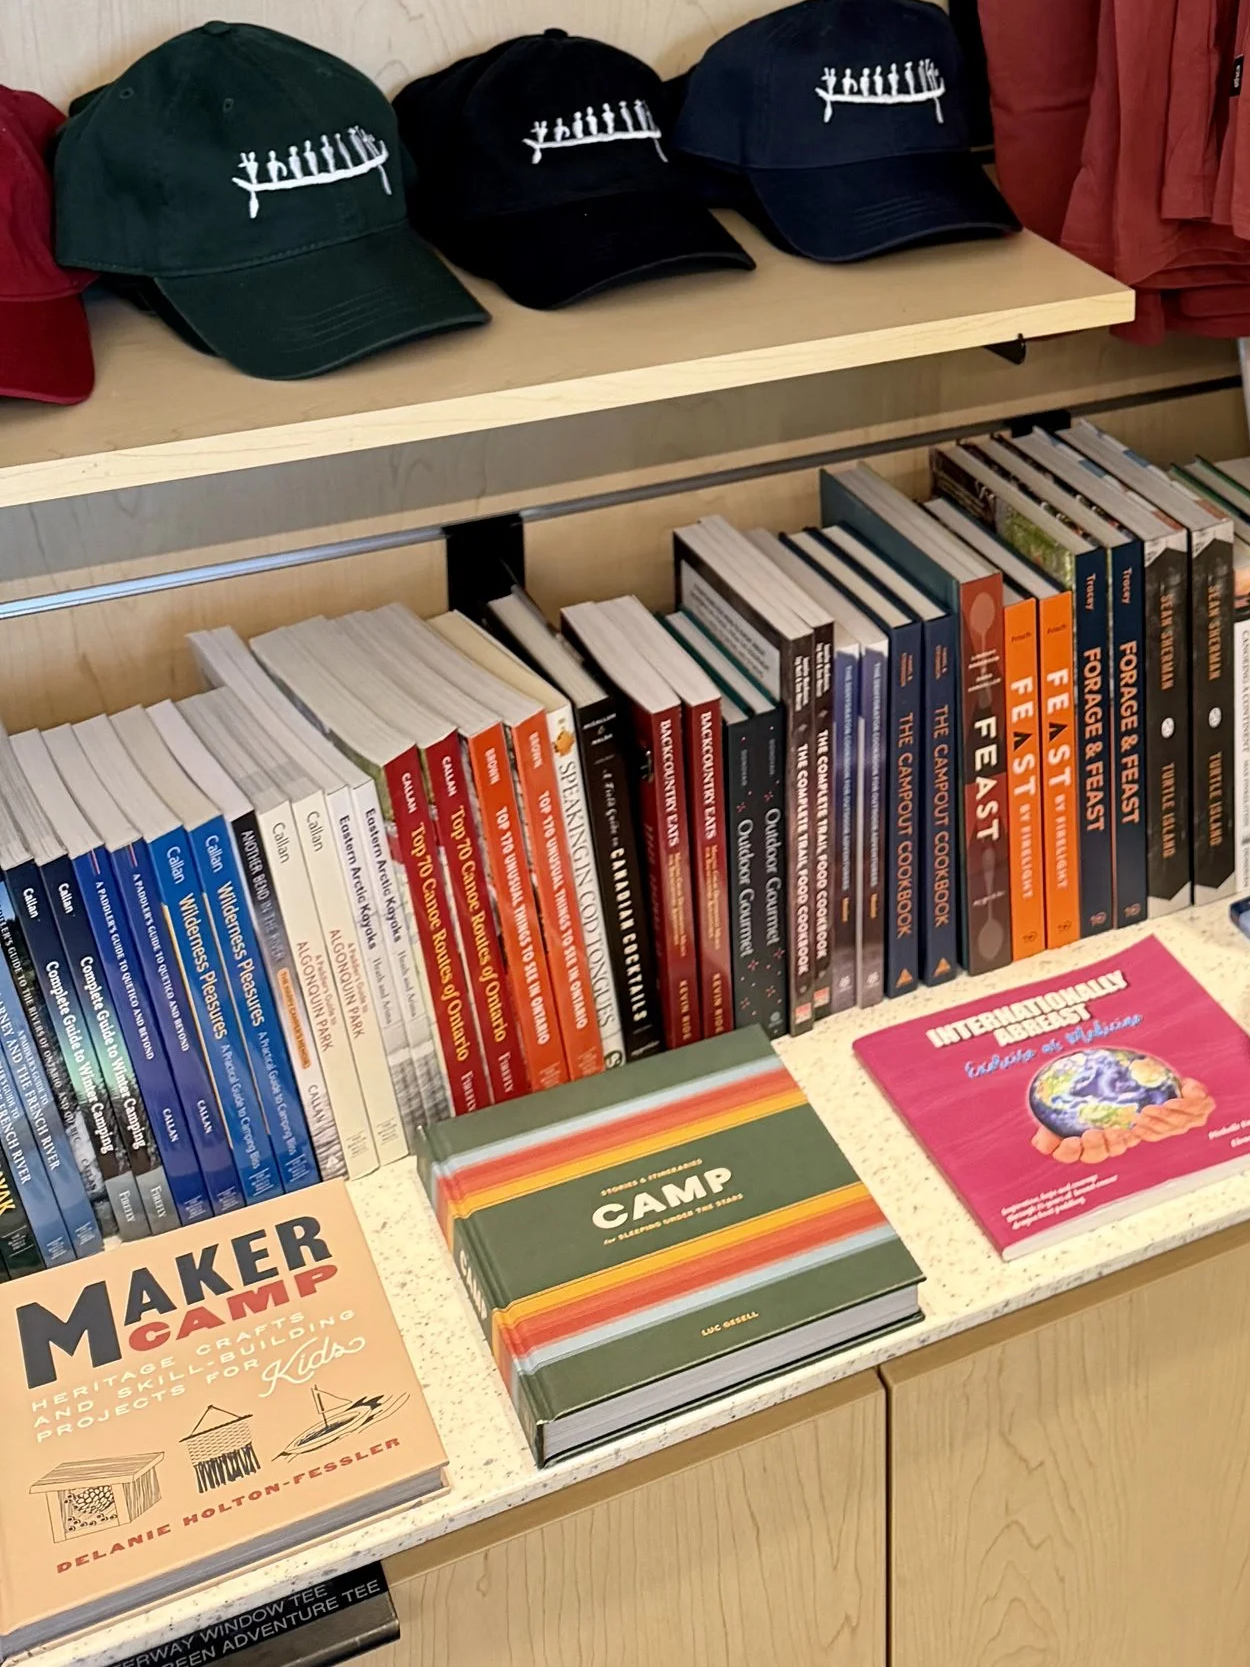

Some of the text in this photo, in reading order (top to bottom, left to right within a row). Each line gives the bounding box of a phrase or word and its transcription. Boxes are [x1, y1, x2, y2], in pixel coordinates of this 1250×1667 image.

[1085, 572, 1097, 612] Tracey
[1160, 592, 1175, 692] SEAN SHERMAN
[1010, 675, 1036, 797] FEAST
[1083, 646, 1105, 832] FORAGE & FEAST
[401, 772, 418, 814] CALLAN
[659, 718, 678, 814] BACKCOUNTRY
[973, 715, 1000, 842] FEAST
[306, 810, 324, 853] Callan
[411, 821, 425, 856] Top
[496, 806, 509, 830] TOP
[666, 813, 680, 848] EATS
[897, 711, 914, 940] THE CAMPOUT COOKBOOK
[1161, 762, 1177, 860] TURTLE ISLAND
[272, 821, 290, 864] Callan
[417, 854, 435, 879] 70
[500, 829, 515, 855] 170
[1021, 824, 1034, 900] FIRELIGHT
[23, 887, 39, 919] Callan
[58, 883, 74, 914] Callan
[339, 814, 377, 951] Eastern Arctic Kayaks
[421, 876, 443, 932] Canoe
[504, 853, 524, 906] UNUSUAL
[559, 760, 616, 1028] SPEAKING IN COD TONGUES
[610, 847, 636, 931] CANADIAN
[737, 818, 755, 959] Outdoor Gourmet
[764, 807, 782, 946] Outdoor Gourmet
[166, 846, 228, 1041] Callan Wilderness Pleasures
[205, 834, 265, 1028] Callan Wilderness Pleasures
[512, 904, 532, 949] THINGS
[432, 927, 453, 984] Routes
[521, 946, 536, 963] TO
[524, 961, 539, 984] SEE
[622, 932, 648, 1023] COCKTAILS
[46, 960, 71, 1015] Complete
[80, 956, 104, 1011] Complete
[296, 941, 335, 1052] ALGONQUIN PARK
[329, 928, 366, 1040] ALGONQUIN PARK
[440, 982, 456, 1002] of
[528, 982, 542, 998] IN
[925, 969, 1129, 1049] INTERNATIONALLY
[63, 1014, 83, 1051] Guide
[96, 1009, 117, 1045] Guide
[447, 998, 471, 1062] Ontario
[529, 995, 551, 1046] ONTARIO
[993, 1002, 1093, 1047] ABREAST
[74, 1048, 85, 1063] to
[108, 1042, 119, 1058] to
[112, 1056, 132, 1099] Winter
[79, 1061, 99, 1103] Winter
[90, 1101, 113, 1155] Camping
[124, 1097, 146, 1150] Camping
[591, 1167, 732, 1230] CAMP
[600, 1158, 703, 1197] STORIES & ITINERARIES
[603, 1193, 744, 1246] for SLEEPING UNDER THE STARS
[15, 1215, 334, 1390] MAKER
[128, 1263, 339, 1352] CAMP
[701, 1311, 760, 1337] LUC GESELL
[32, 1312, 306, 1413] HERITAGE CRAFTS
[34, 1309, 356, 1429] AND SKILL-BUILDING
[36, 1335, 367, 1444] PROJECTS FOR Kids
[55, 1436, 402, 1575] DELANIE HOLTON-FESSLER
[113, 1635, 196, 1667] ERWAY
[199, 1600, 286, 1645] WINDOW
[288, 1583, 328, 1610] TEE
[221, 1596, 341, 1660] ADVENTURE
[342, 1578, 381, 1607] TEE
